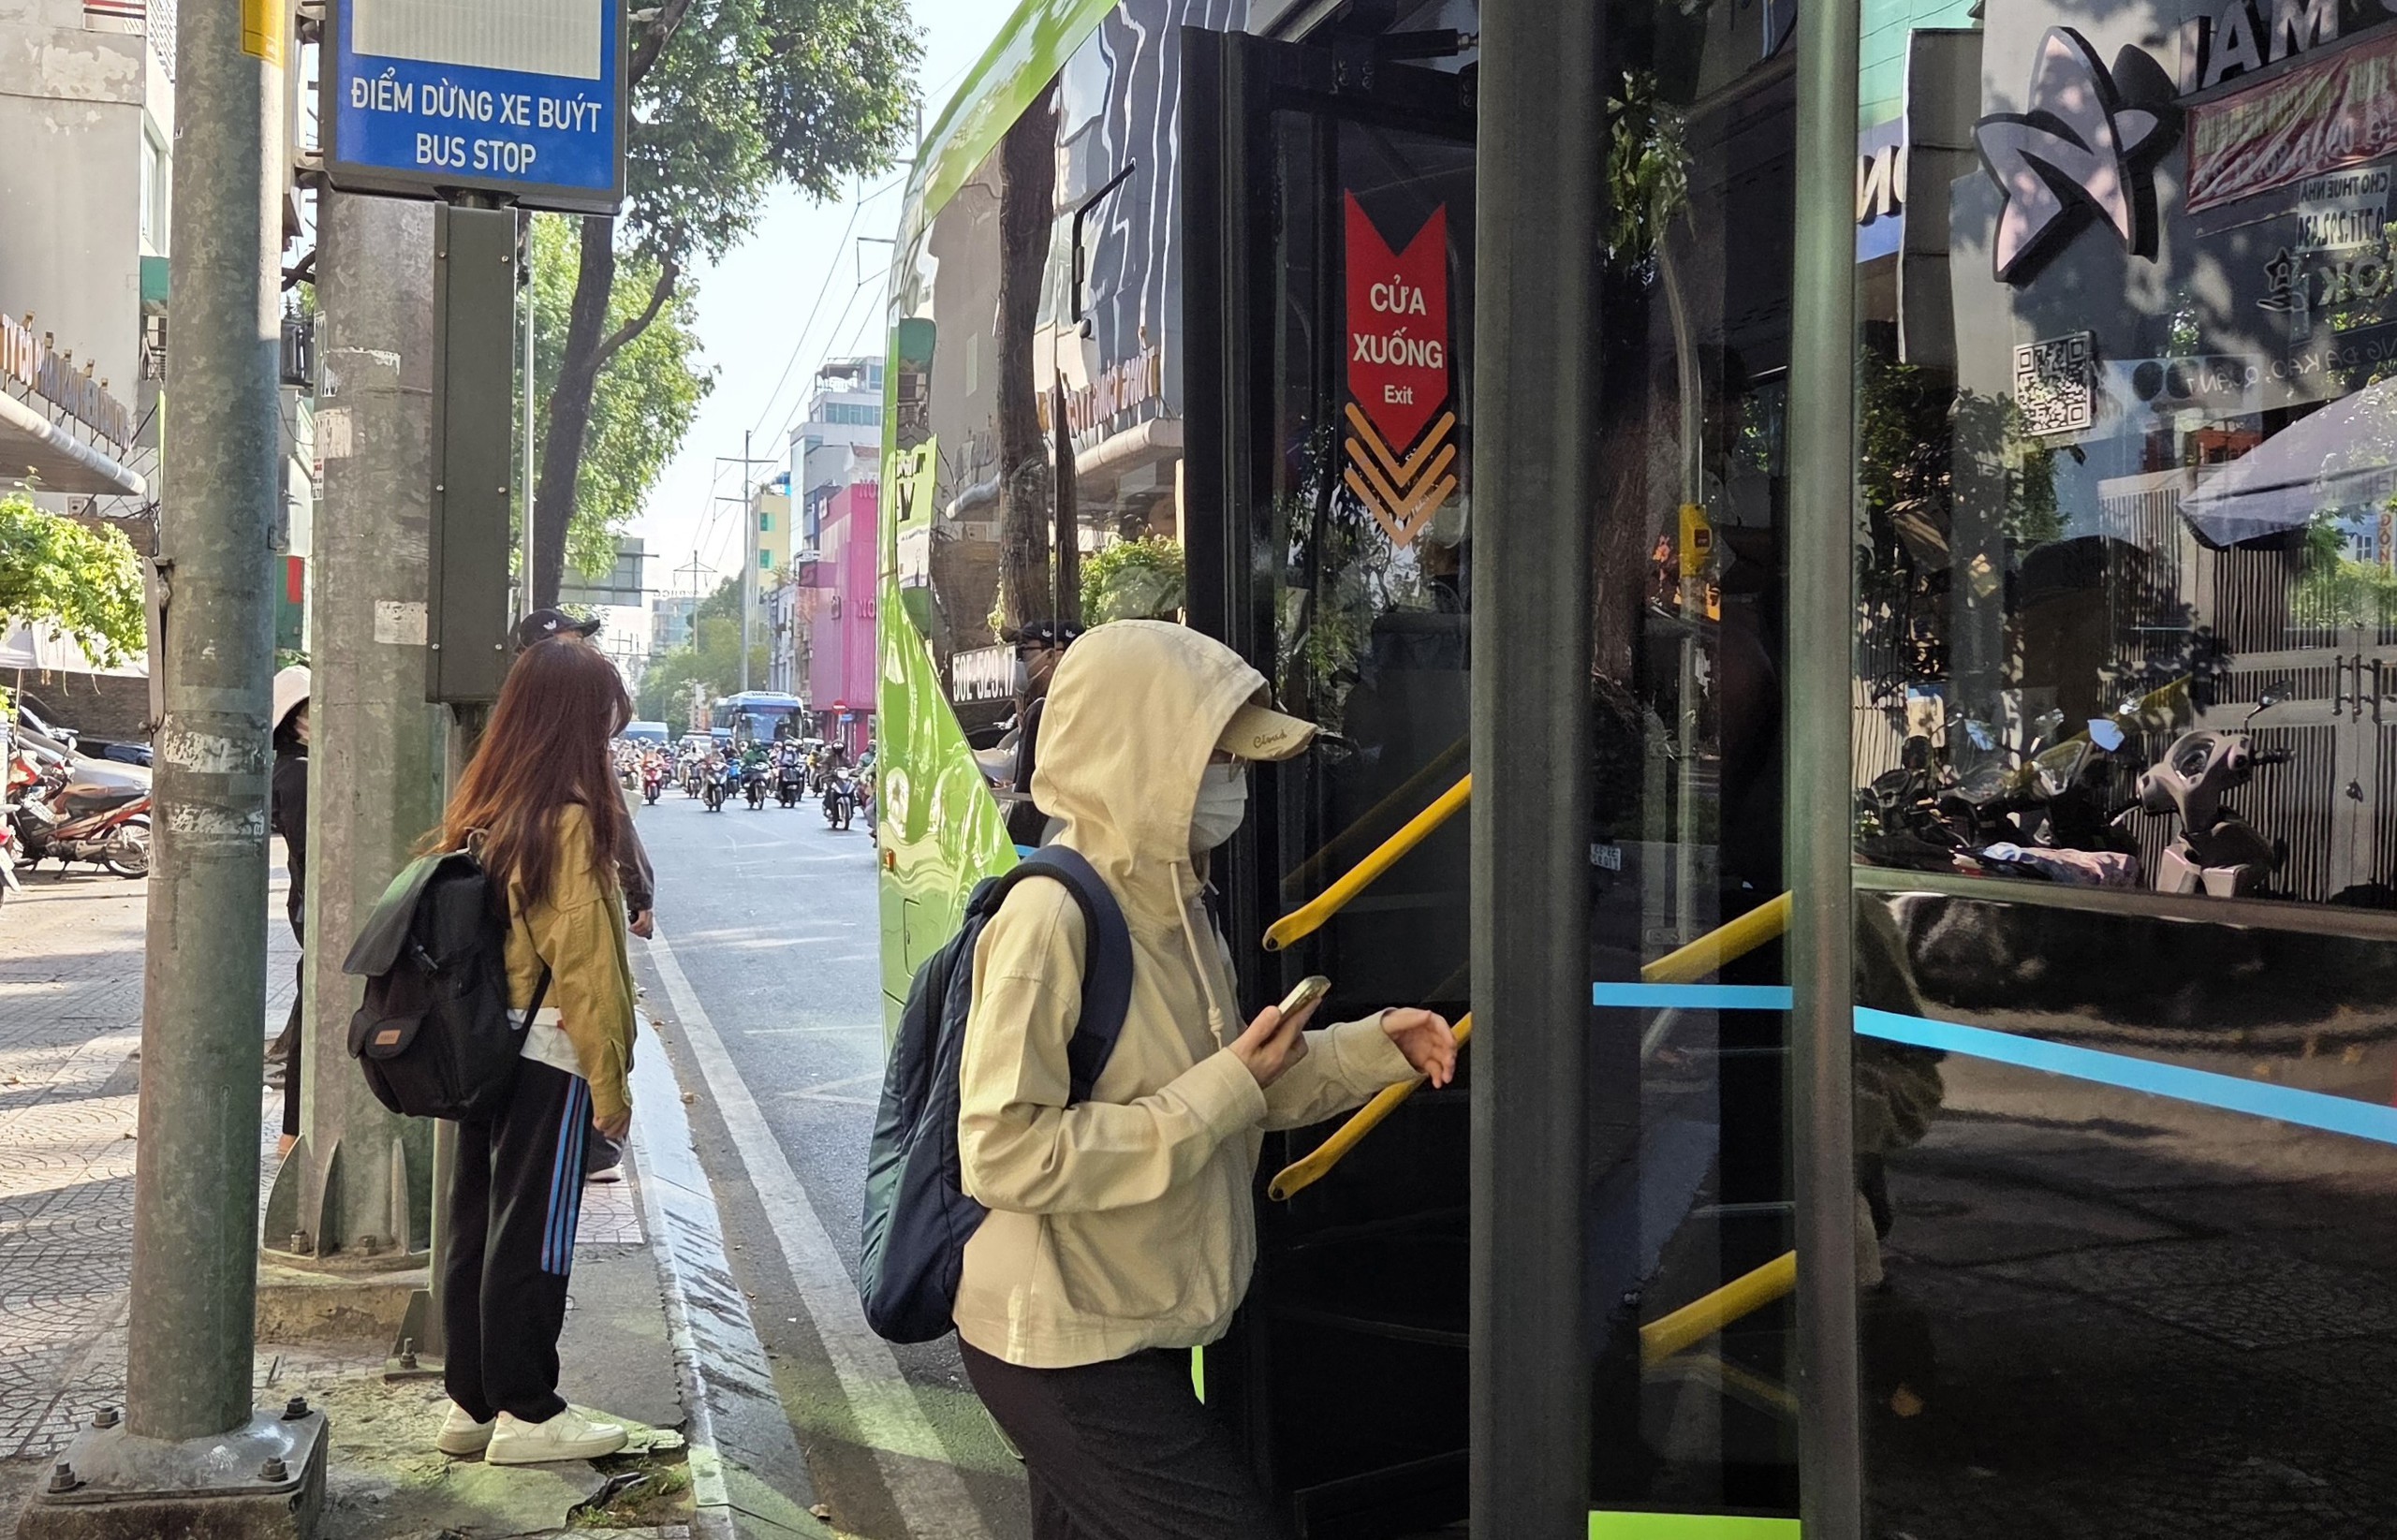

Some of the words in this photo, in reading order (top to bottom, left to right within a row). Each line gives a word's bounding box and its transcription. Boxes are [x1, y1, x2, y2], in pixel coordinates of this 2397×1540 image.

[351, 66, 413, 113] ĐIỂM
[420, 78, 493, 122] DỪNG
[499, 94, 531, 126] XE
[537, 93, 602, 133] BUÝT
[416, 133, 466, 169] BUS
[472, 139, 537, 174] STOP
[1370, 274, 1426, 315] CỬA
[1353, 327, 1443, 369] XUỐNG
[1384, 385, 1413, 405] Exit
